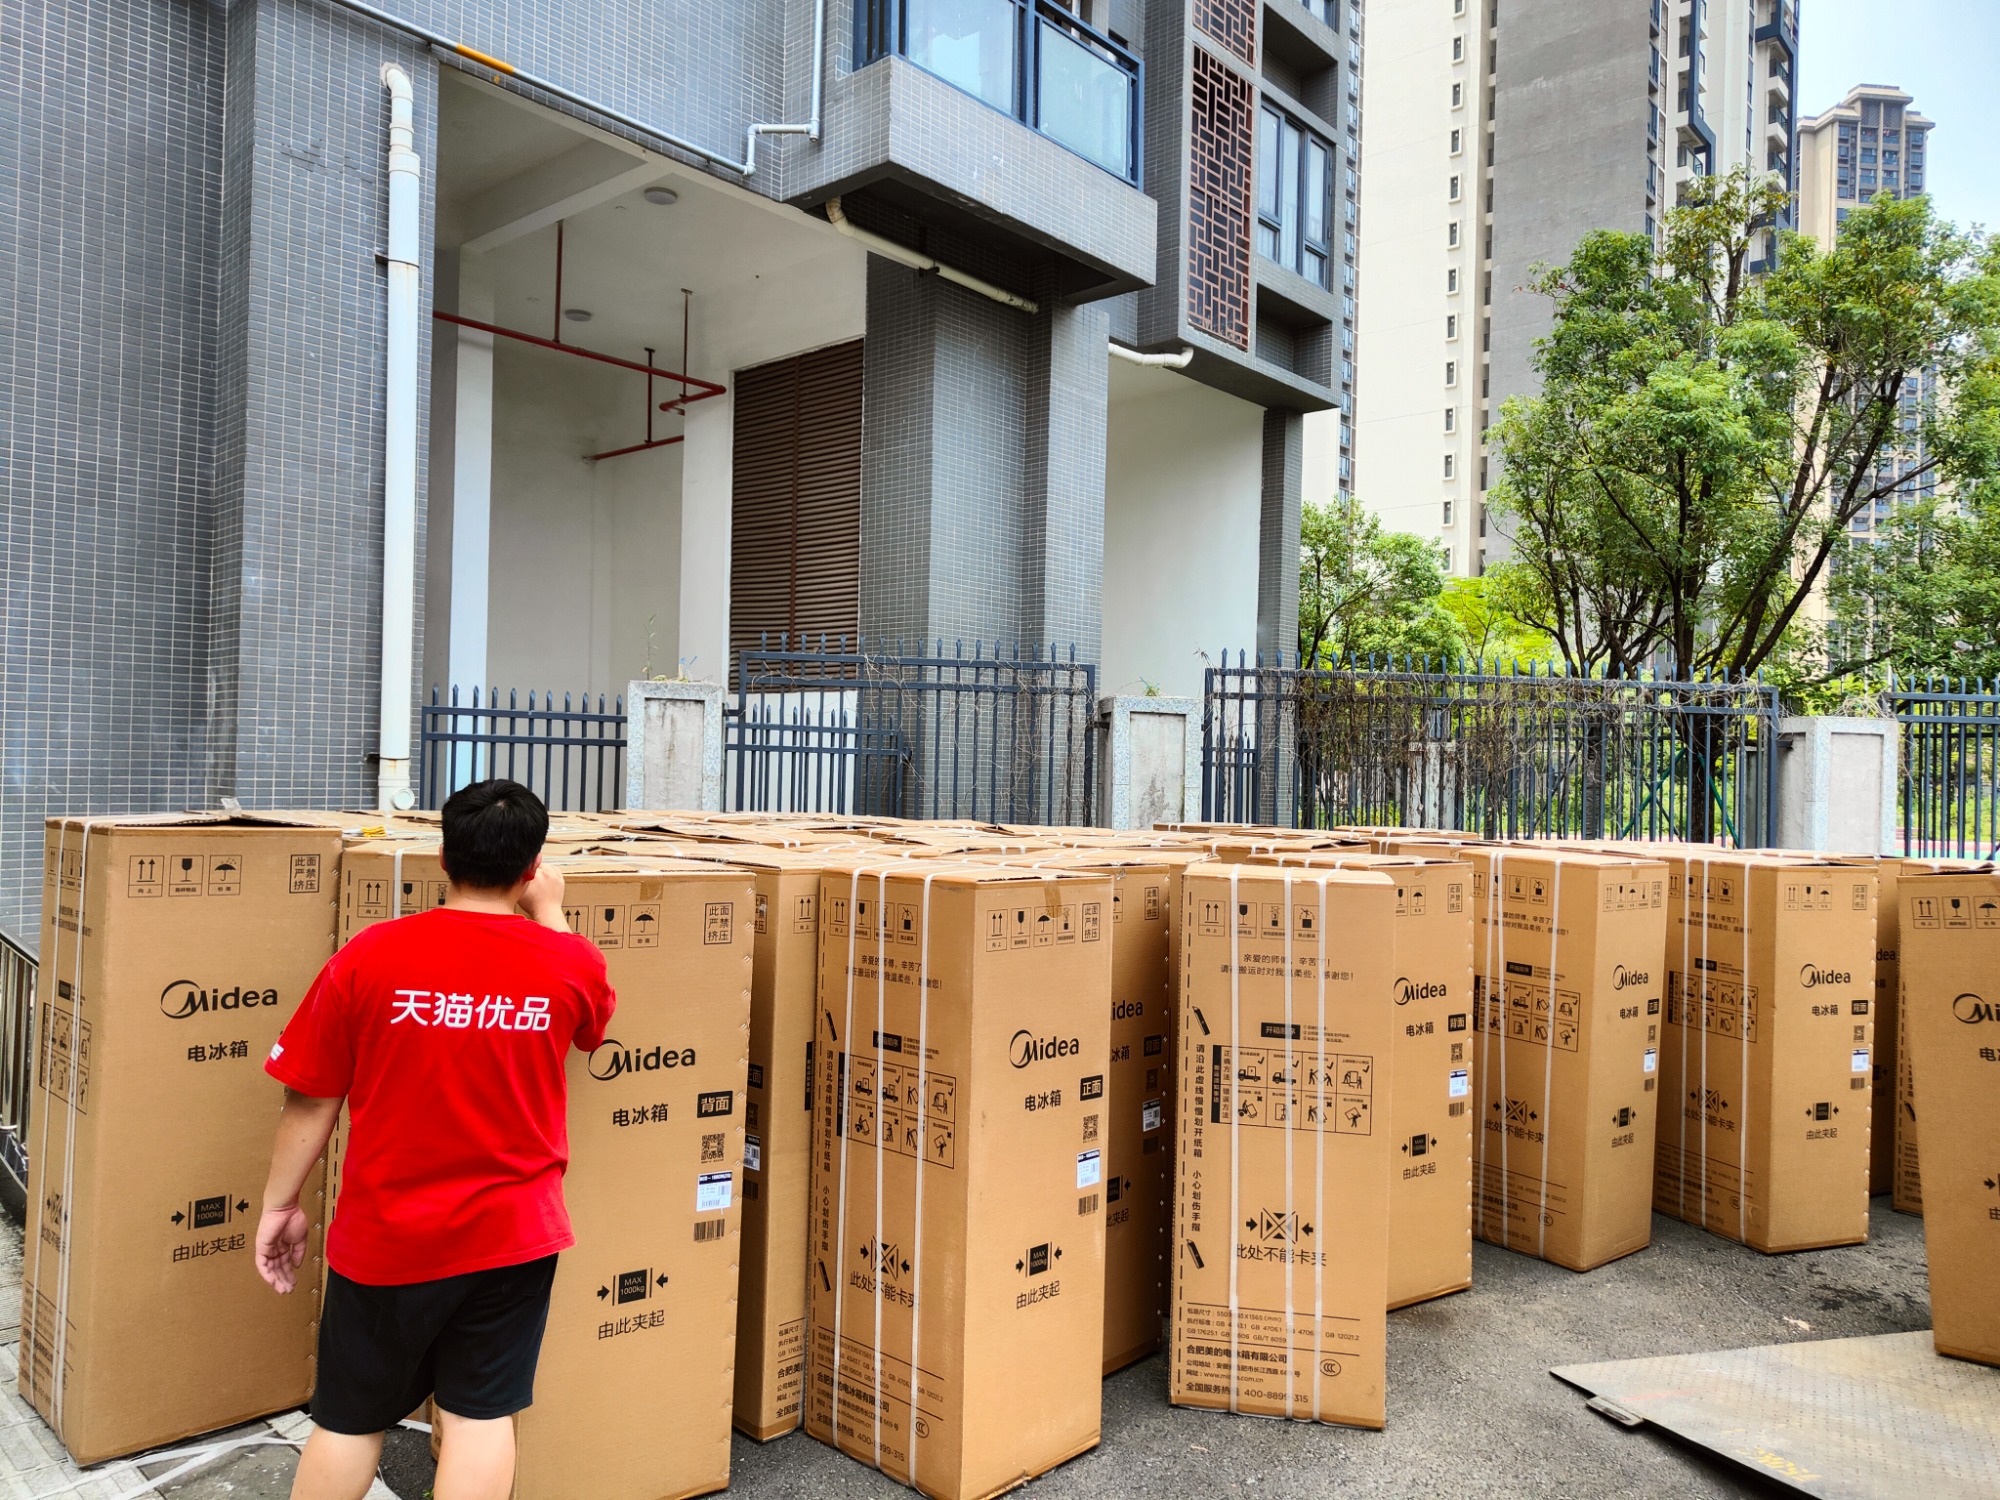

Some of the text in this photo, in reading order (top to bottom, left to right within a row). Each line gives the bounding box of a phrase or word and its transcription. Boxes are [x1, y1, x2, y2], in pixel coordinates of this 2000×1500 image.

[294, 857, 316, 867] 此面
[294, 868, 316, 879] 严禁
[293, 880, 316, 890] 挤压
[708, 906, 730, 917] 此面
[708, 918, 729, 929] 严禁
[707, 930, 729, 942] 挤压
[1876, 948, 1895, 961] dea
[1613, 964, 1648, 990] Midea
[1800, 964, 1851, 988] Midea
[160, 980, 278, 1019] Midea
[1394, 977, 1446, 1006] Midea
[390, 990, 551, 1031] 天猫优品
[1112, 1000, 1143, 1020] idea
[1620, 1006, 1639, 1020] 电冰箱
[1812, 1004, 1838, 1016] 电冰箱
[1406, 1022, 1434, 1036] 电冰箱
[187, 1040, 248, 1062] 电冰箱
[1010, 1030, 1079, 1069] Midea
[1111, 1045, 1130, 1062] 冰箱
[588, 1039, 696, 1081] Midea
[1082, 1080, 1101, 1096] 正面
[701, 1097, 730, 1113] 背面
[1024, 1089, 1062, 1112] 电冰箱
[612, 1103, 668, 1127] 电冰箱
[1191, 1044, 1205, 1232] 请沿此虚线慢慢划开纸箱 小心划伤手指
[1402, 1162, 1436, 1180] 由此夹起
[201, 1202, 220, 1212] MAX
[197, 1212, 224, 1221] 1000kg
[172, 1233, 246, 1263] 由此夹起
[1033, 1250, 1046, 1259] MAX
[1030, 1257, 1047, 1268] 1000kg
[624, 1277, 643, 1286] MAX
[620, 1285, 645, 1295] 1000kg
[1016, 1280, 1061, 1310] 由此夹起
[598, 1309, 665, 1340] 由此夹起
